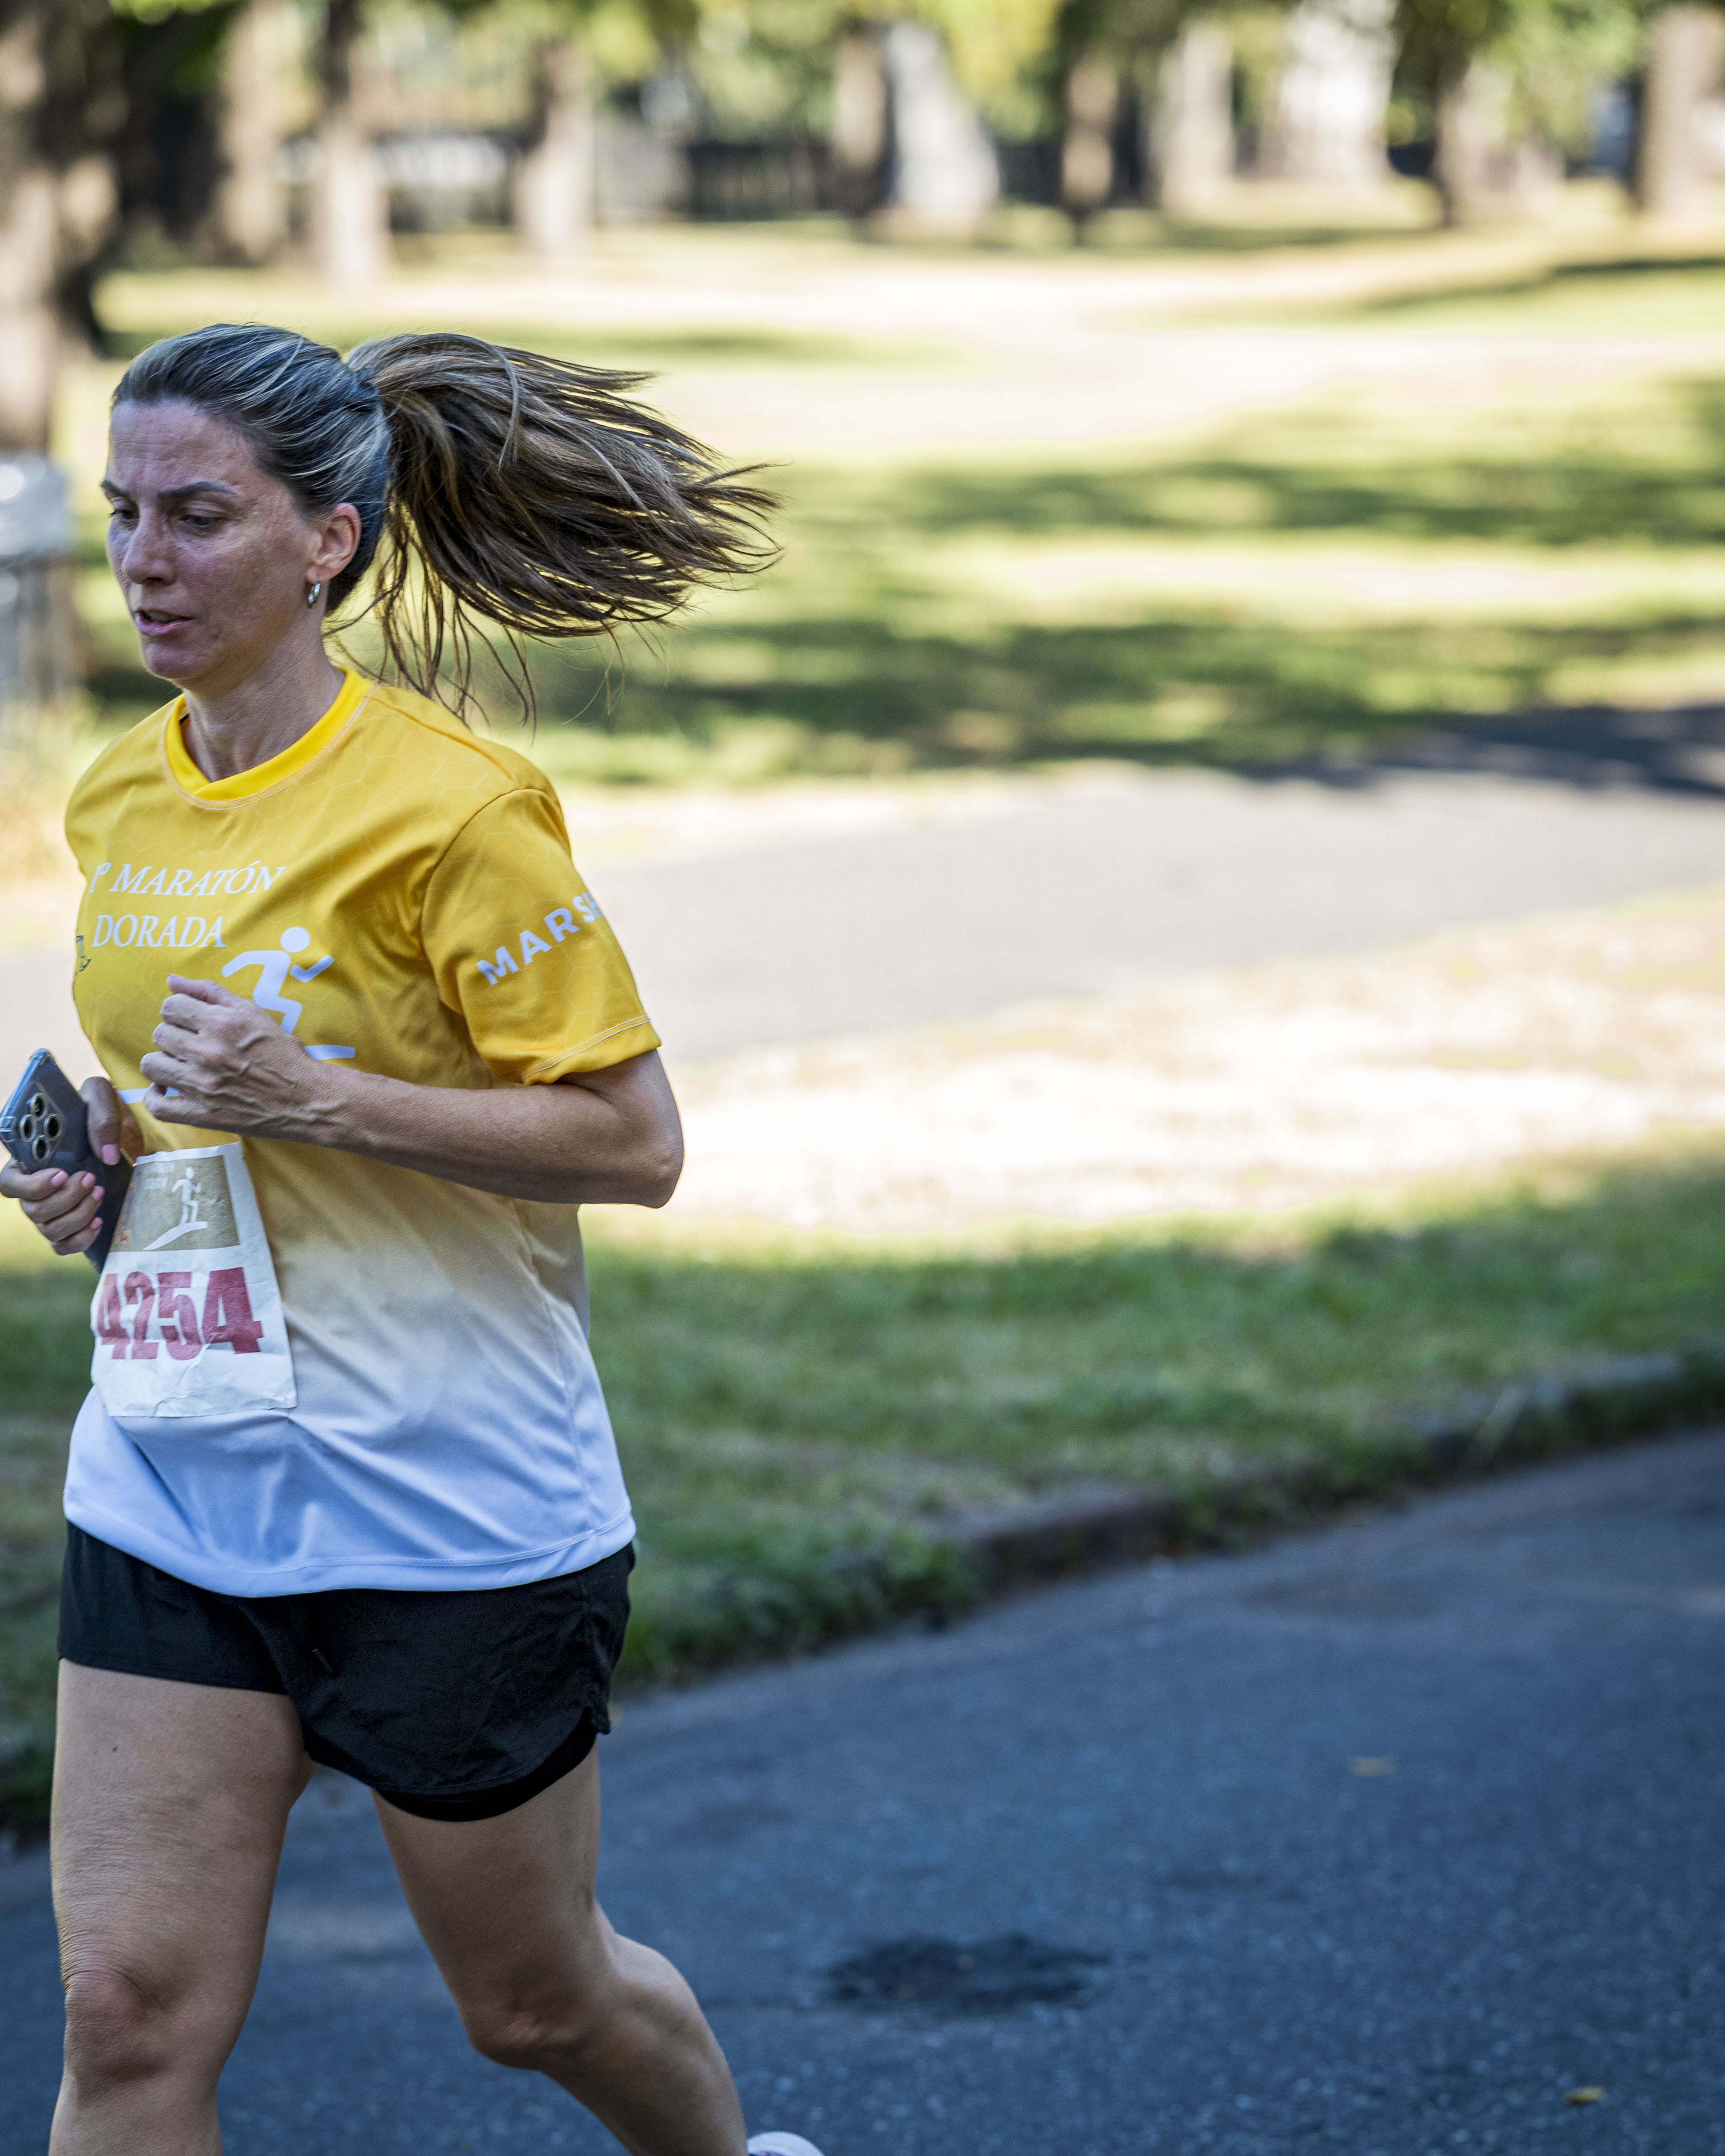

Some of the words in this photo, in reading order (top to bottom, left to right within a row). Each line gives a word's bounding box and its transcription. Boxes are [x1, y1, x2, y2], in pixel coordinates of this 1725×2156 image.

[109, 860, 287, 897] MARATÓN
[91, 914, 226, 948] DORADA
[98, 1267, 264, 1361] 4254
